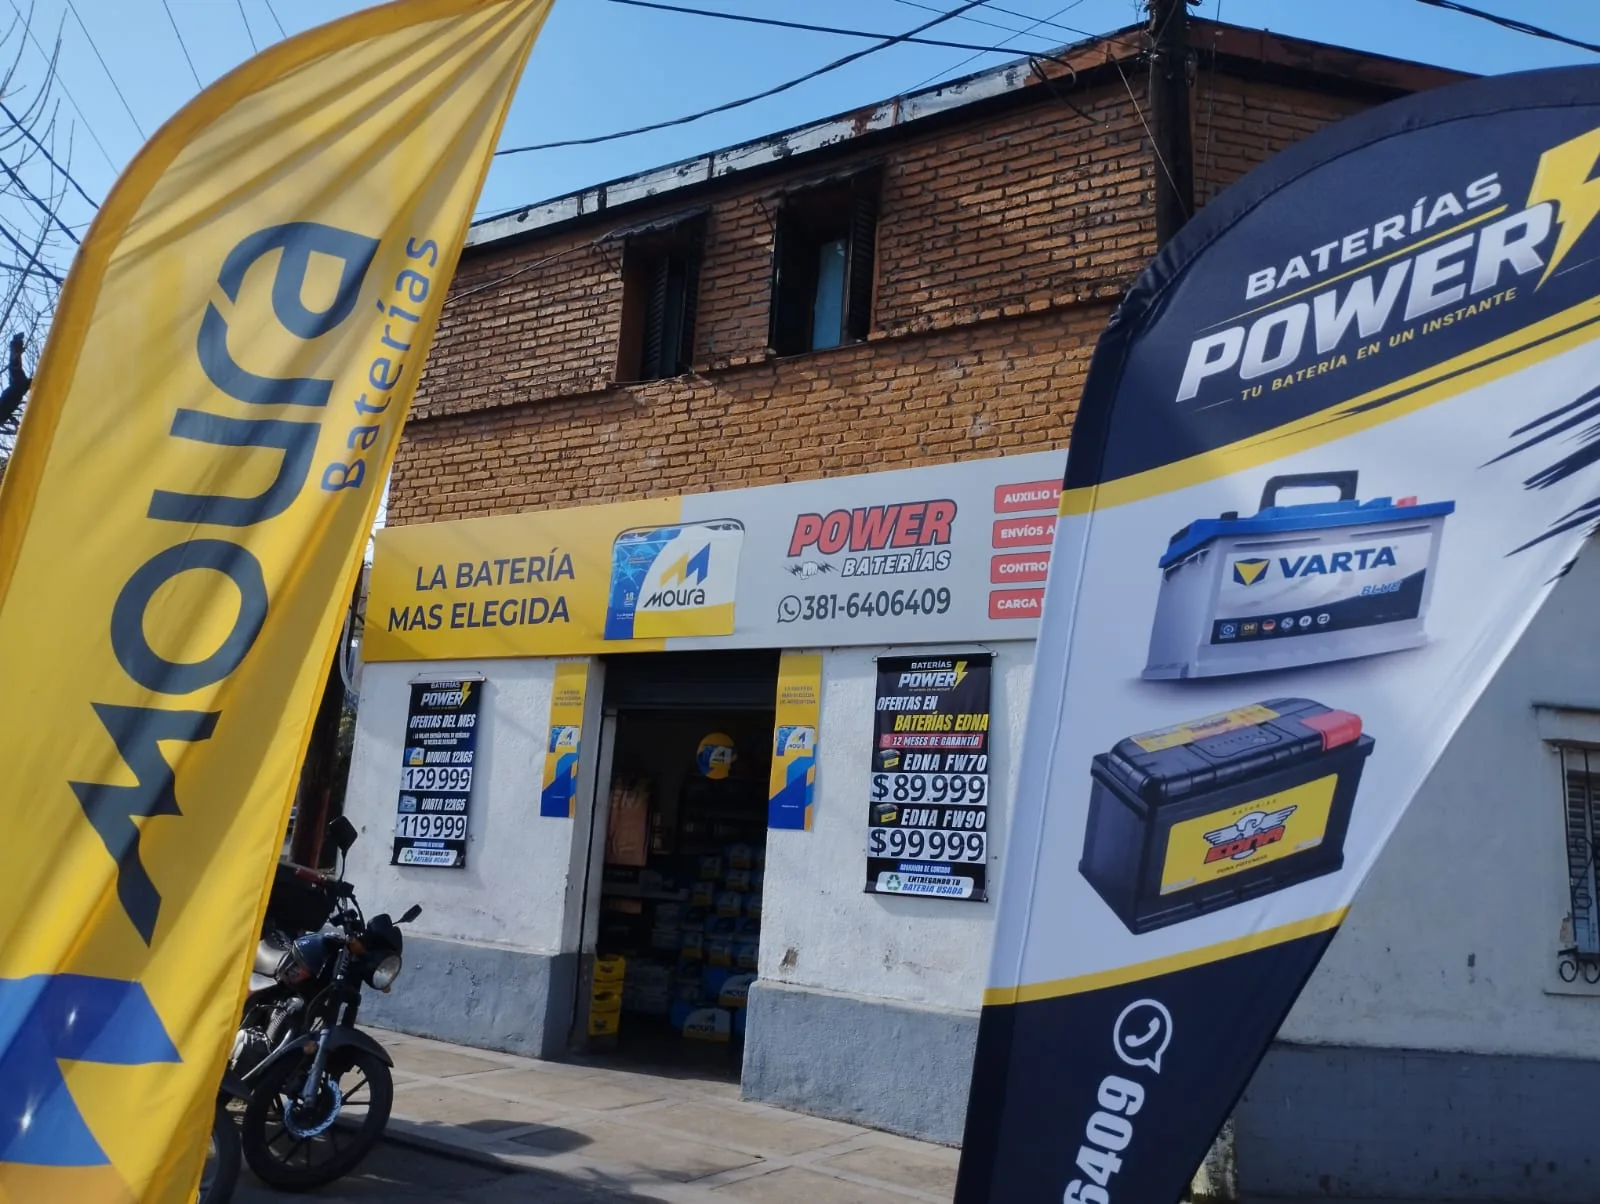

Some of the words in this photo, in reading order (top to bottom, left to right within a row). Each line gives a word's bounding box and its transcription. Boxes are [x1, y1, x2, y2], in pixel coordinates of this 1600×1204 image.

[1245, 172, 1502, 301] BATERÍAS
[1176, 202, 1554, 403] POWER
[1241, 384, 1262, 401] TU
[1272, 354, 1349, 391] BATERÍA
[1356, 341, 1382, 361] EN
[1389, 328, 1415, 348] UN
[1422, 287, 1518, 335] INSTANTE
[320, 236, 439, 492] Baterías
[1004, 490, 1051, 504] AUXILIO
[787, 498, 957, 557] POWER
[1001, 524, 1044, 539] ENVÍOS
[416, 566, 448, 591] LA
[455, 547, 575, 589] BATERÍA
[841, 548, 952, 577] BATERÍAS
[1279, 546, 1397, 578] VARTA
[802, 587, 951, 621] 381-6406409
[997, 598, 1038, 610] CARGA
[388, 604, 442, 632] MAS
[451, 596, 571, 629] ELEGIDA
[911, 661, 952, 669] BATERÍAS
[898, 672, 957, 688] POWER
[420, 692, 462, 706] POWER
[877, 696, 921, 711] OFERTAS
[923, 696, 938, 710] EN
[410, 715, 442, 728] OFERTAS
[442, 715, 456, 728] DEL
[457, 714, 476, 727] MES
[894, 711, 954, 732] BATERÍAS
[954, 714, 989, 731] EDNA
[892, 736, 902, 746] 12
[903, 736, 929, 746] MESES
[930, 737, 941, 746] DE
[941, 734, 979, 746] GARANTÍA
[426, 751, 450, 763] MOURA
[451, 751, 473, 763] 12X65
[903, 754, 940, 771] EDNA
[945, 754, 988, 772] FW70
[407, 768, 470, 789] 129.999
[421, 798, 443, 810] VARTA
[444, 798, 466, 811] 12X65
[901, 808, 939, 827] EDNA
[942, 809, 986, 829] FW90
[908, 875, 950, 886] ENTREGANDO
[951, 878, 961, 886] TU
[936, 885, 963, 895] USADA
[1063, 1075, 1145, 1204] 6409
